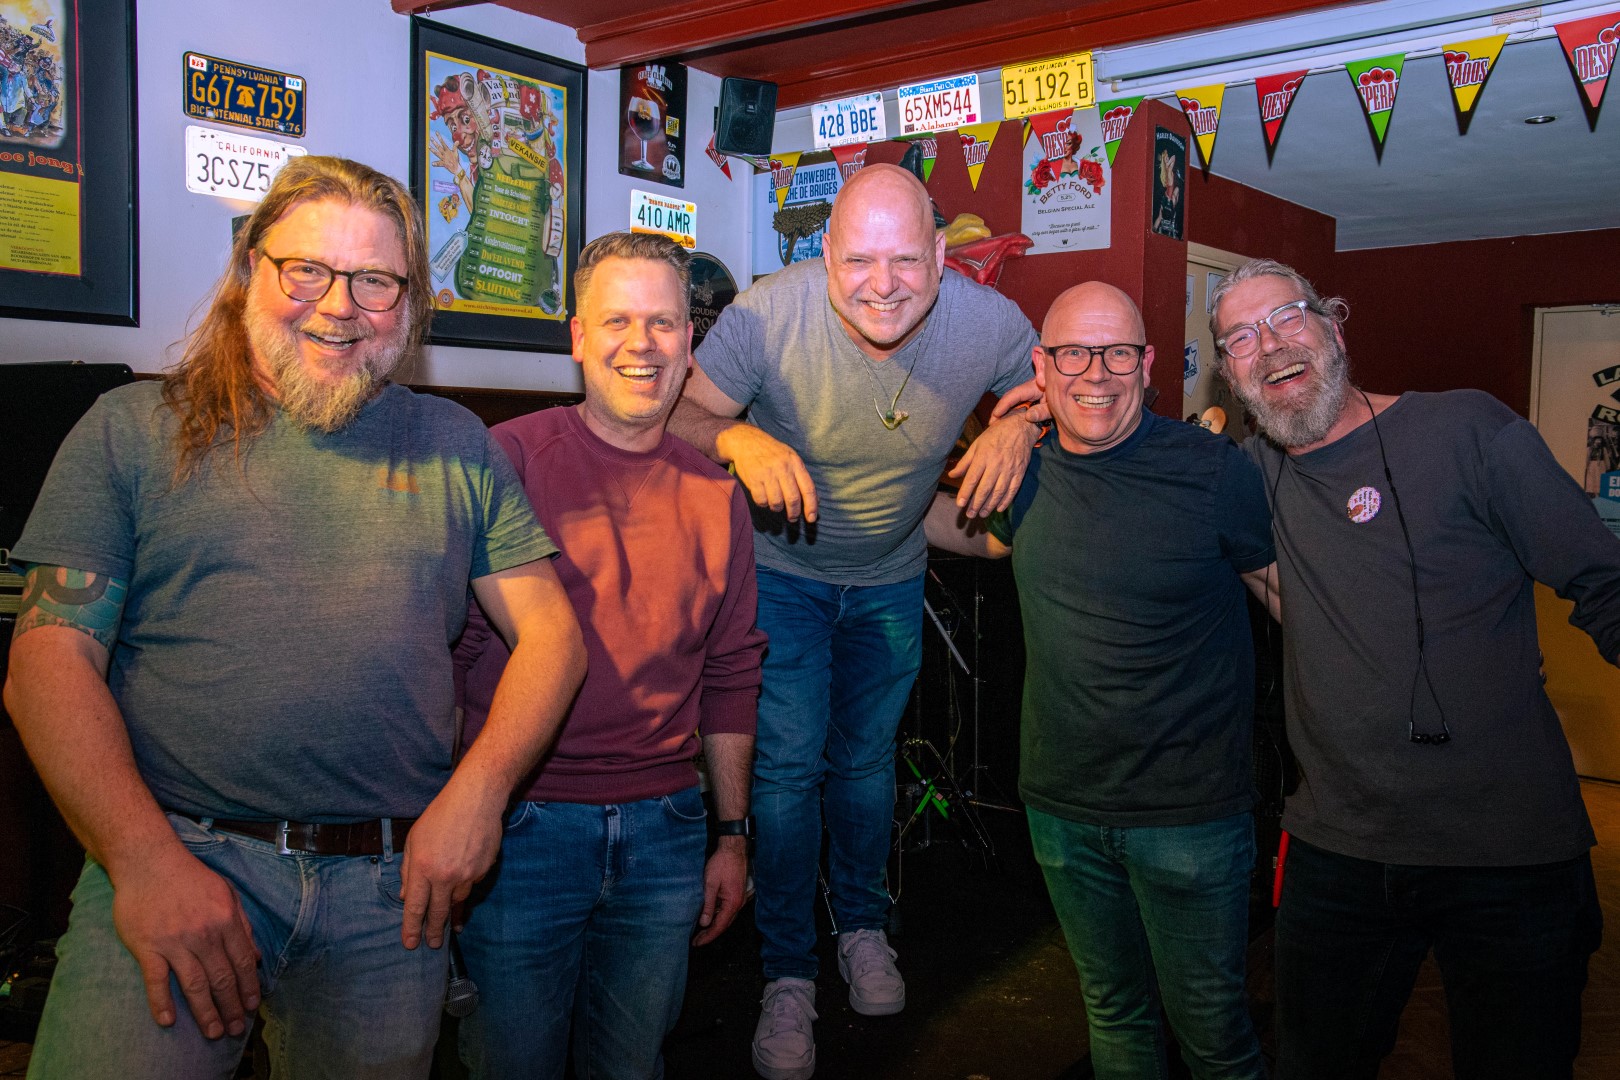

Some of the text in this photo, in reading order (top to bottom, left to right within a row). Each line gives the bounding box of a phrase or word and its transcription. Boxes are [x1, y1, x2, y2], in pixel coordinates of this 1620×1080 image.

[213, 63, 279, 85] PENNSYLVANIA
[1025, 66, 1038, 74] LAND
[1046, 61, 1067, 70] LINCOLN
[945, 81, 955, 89] On
[1006, 78, 1028, 105] 51
[1035, 72, 1070, 102] 192
[192, 71, 297, 121] G67 759
[491, 91, 520, 100] avnd
[905, 88, 972, 123] 65XM544
[190, 103, 254, 125] BICENTENNIAL
[255, 116, 279, 128] STATE
[1025, 105, 1037, 114] JUN
[1038, 102, 1062, 111] ILLINOIS
[819, 106, 878, 140] 428 BBE
[920, 121, 959, 131] Alabama
[218, 141, 280, 160] CALIFORNIA
[838, 136, 860, 145] GREENE
[510, 139, 546, 169] VEKANSIE
[795, 167, 836, 186] TARWEBIER
[768, 186, 798, 204] BLHE
[799, 185, 808, 199] DE
[809, 181, 838, 198] BRUGES
[1039, 181, 1092, 205] BETTY FORD
[489, 209, 529, 227] INTOCHT
[637, 204, 691, 234] 410 AMR
[478, 264, 523, 283] OPTOCHT
[475, 279, 522, 299] SLUITING
